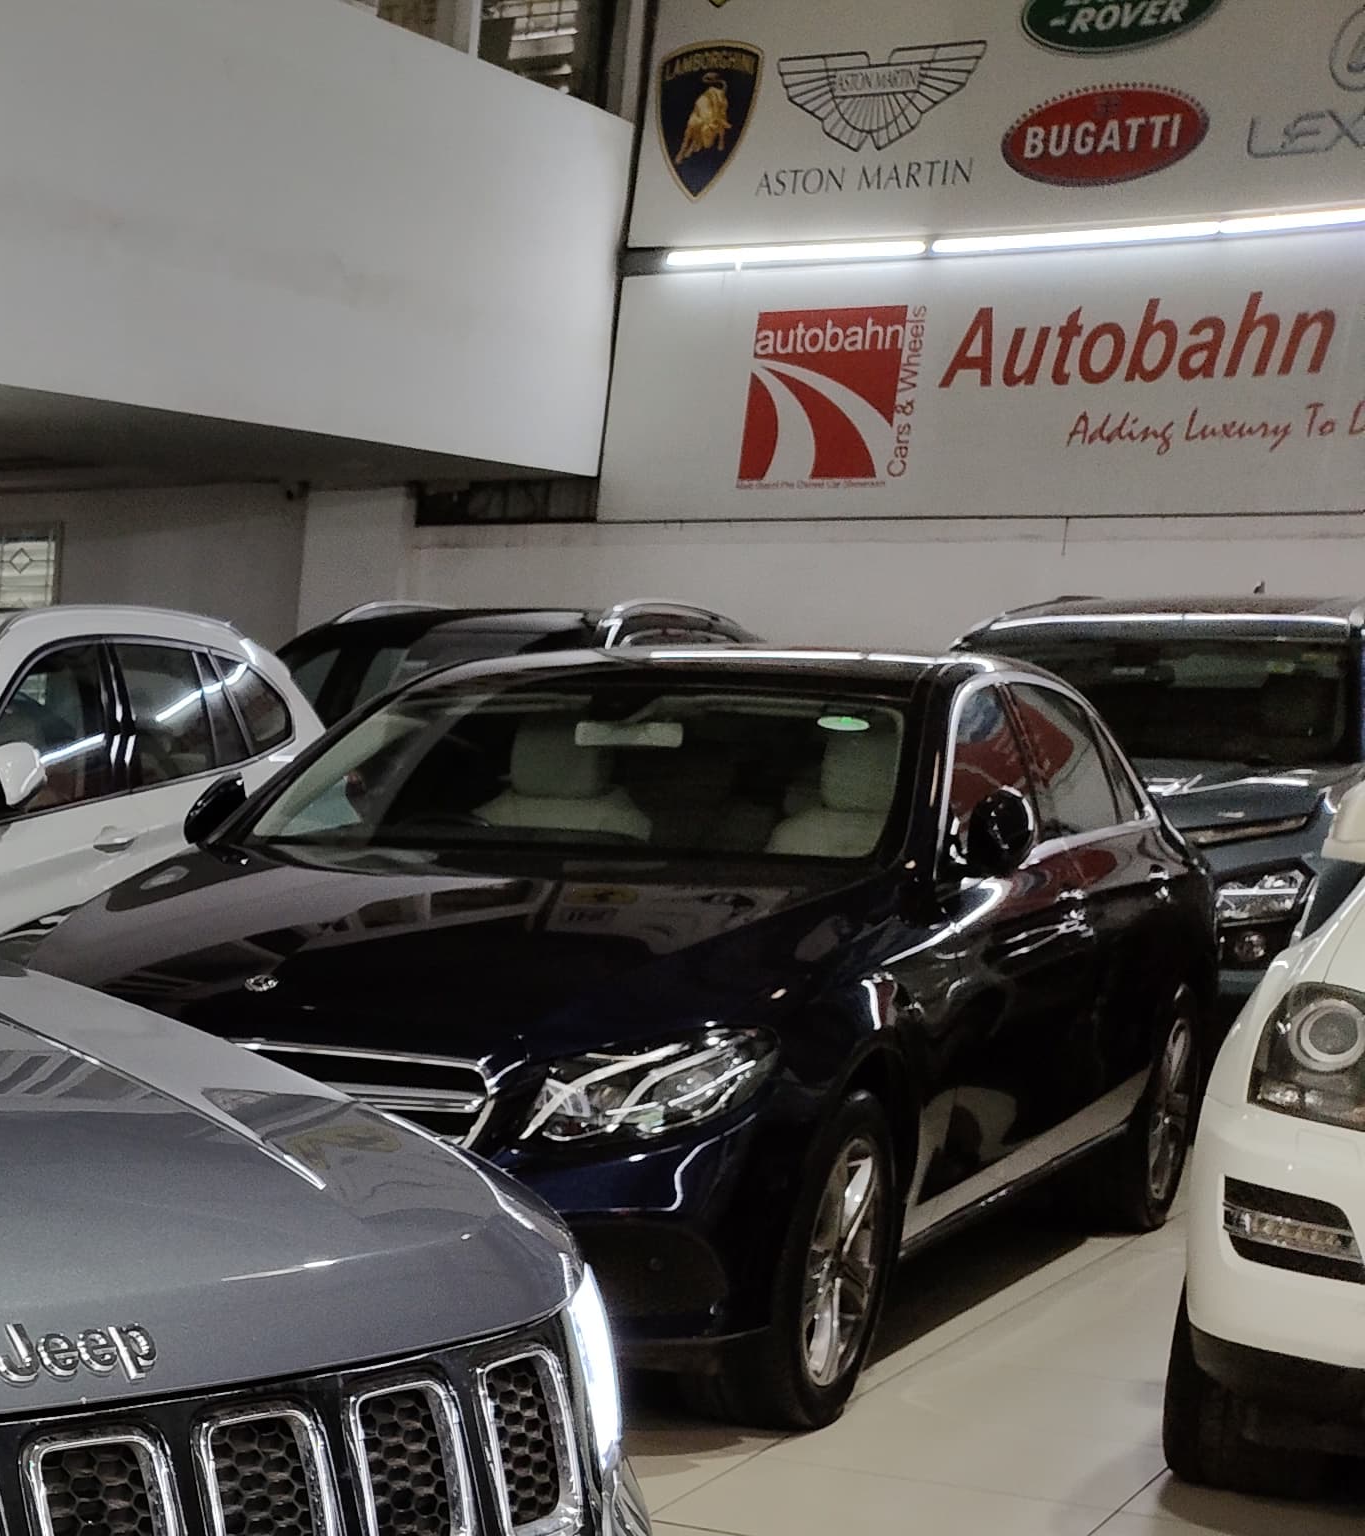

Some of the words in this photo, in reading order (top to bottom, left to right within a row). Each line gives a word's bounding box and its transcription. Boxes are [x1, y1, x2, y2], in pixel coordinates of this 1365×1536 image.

[1022, 114, 1184, 160] BUGATTI
[755, 166, 845, 197] ASTON
[857, 157, 974, 192] MARTIN
[754, 317, 904, 356] autobahn
[898, 304, 927, 392] Wheels
[937, 291, 1336, 389] Autobahn
[895, 400, 915, 416] &
[1067, 410, 1175, 456] Adding
[1184, 407, 1293, 453] Luxury
[1305, 401, 1336, 438] To
[886, 424, 911, 478] Cars
